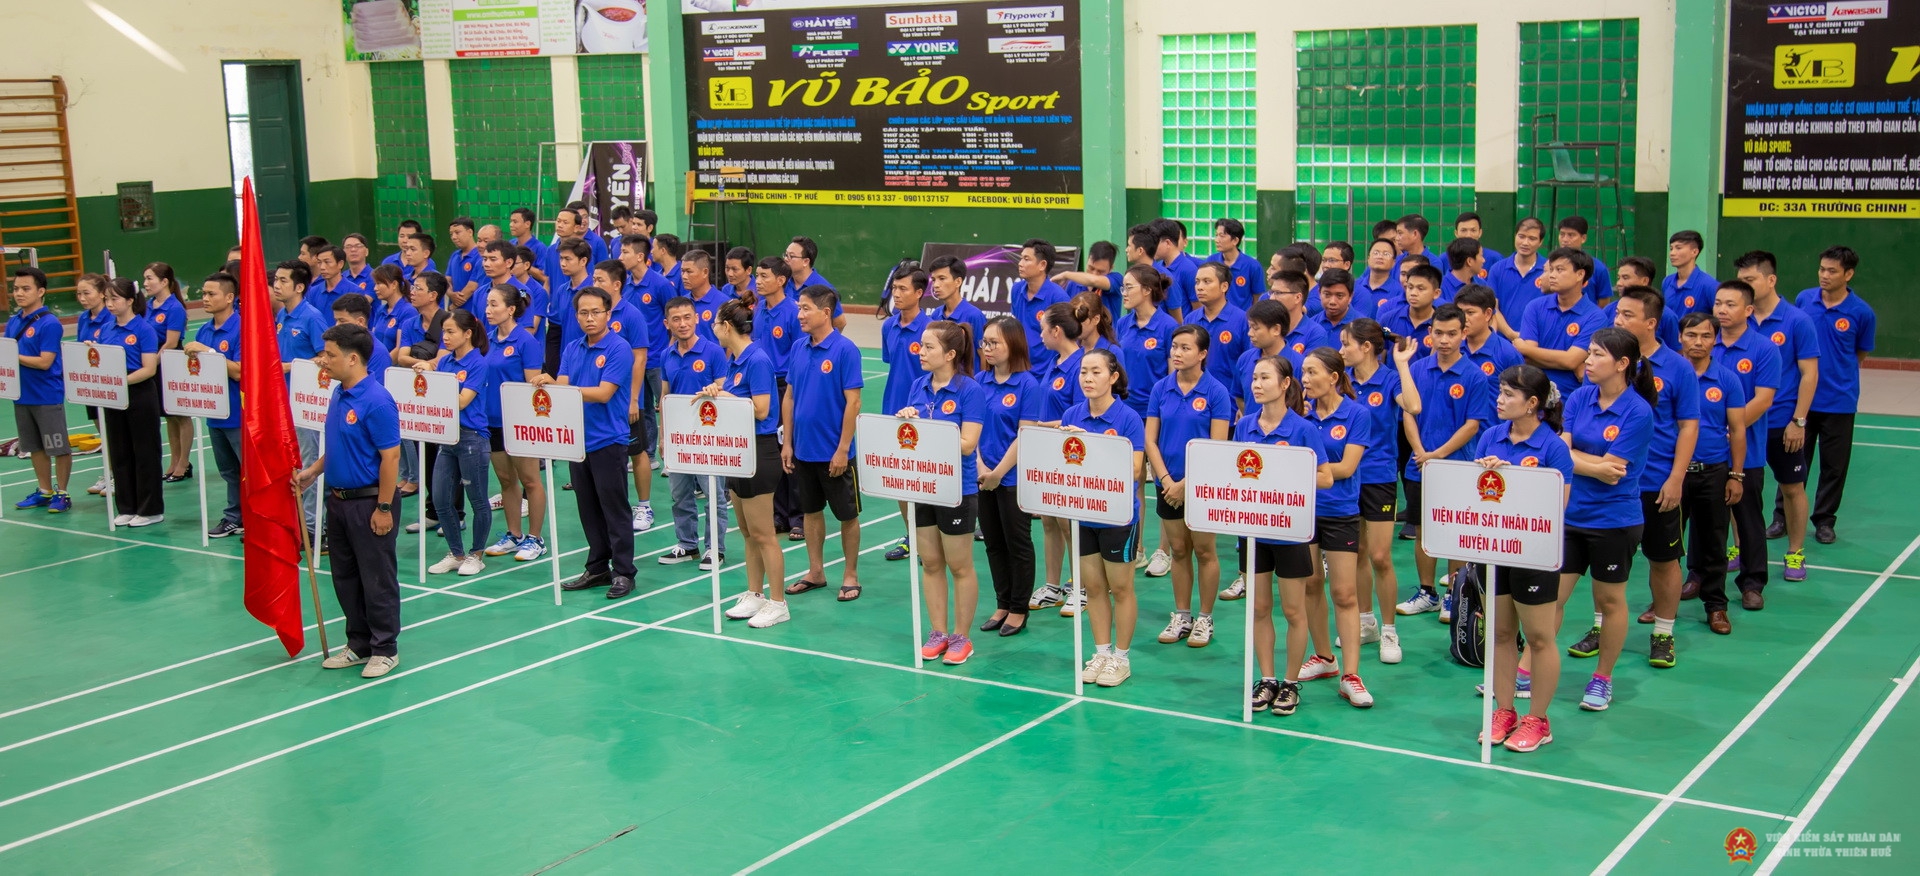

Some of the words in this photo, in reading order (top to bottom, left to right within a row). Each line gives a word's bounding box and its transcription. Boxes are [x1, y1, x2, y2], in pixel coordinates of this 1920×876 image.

[1004, 12, 1048, 20] Flypower
[1784, 5, 1826, 16] VICTOR
[1832, 6, 1882, 16] kawasaki
[804, 17, 827, 28] HẢI
[889, 14, 952, 25] Sunbatta
[913, 42, 956, 53] YONEX
[768, 71, 841, 108] VŨ
[850, 68, 970, 106] BẢO
[966, 90, 1061, 115] Sport
[1745, 120, 1764, 137] NHẬN
[1765, 122, 1778, 137] DẠY
[1779, 120, 1794, 134] KÈM
[1795, 119, 1809, 134] CÁC
[1810, 121, 1833, 133] KHUNG
[1834, 118, 1847, 133] GIỜ
[1848, 121, 1865, 133] THEO
[1866, 118, 1882, 133] THỜI
[1883, 120, 1901, 133] GIAN
[1902, 116, 1916, 132] CỦA
[1744, 139, 1753, 153] VŨ
[1754, 138, 1768, 153] BẢO
[1769, 140, 1792, 153] SPORT:
[1744, 157, 1762, 174] NHẬN
[1765, 155, 1774, 171] TỔ
[1774, 157, 1792, 171] CHỨC
[1794, 156, 1807, 171] GIẢI
[1809, 159, 1823, 171] CHO
[1824, 157, 1838, 171] CÁC
[1839, 158, 1849, 171] CƠ
[1850, 159, 1870, 172] QUAN,
[1872, 157, 1891, 171] ĐOÀN
[1743, 176, 1762, 192] NHẬN
[1792, 176, 1802, 190] CỜ
[1802, 174, 1818, 191] GIẢI,
[1820, 177, 1833, 190] LƯU
[1834, 176, 1854, 193] NIỆM,
[1855, 178, 1868, 190] HUY
[1870, 177, 1899, 190] CHƯƠNG
[1900, 176, 1914, 190] CÁC
[766, 192, 787, 200] CHINH
[794, 192, 802, 200] TP
[804, 190, 818, 200] HUẾ
[847, 193, 865, 201] 0905
[867, 194, 879, 202] 613
[882, 194, 896, 202] 337
[904, 195, 949, 203] 0901137157
[968, 196, 1010, 204] FACEBOOK:
[1025, 194, 1042, 204] BẢO
[1044, 196, 1070, 205] SPORT
[1759, 202, 1779, 212] ĐC:
[1784, 203, 1807, 212] 33A
[1810, 200, 1862, 212] TRƯỜNG
[1866, 203, 1907, 212] CHINH
[960, 267, 1000, 303] HẢI
[168, 380, 179, 393] VIỆN
[179, 380, 190, 392] KIỂM
[191, 382, 199, 393] SÁT
[200, 383, 213, 394] NHÂN
[214, 384, 223, 395] DÂN
[177, 396, 191, 410] HUYỆN
[192, 399, 202, 409] NAM
[295, 391, 305, 404] VIỆN
[306, 391, 318, 405] KIỂM
[319, 395, 328, 407] SÁT
[403, 400, 415, 414] KIỂM
[416, 403, 425, 415] SÁT
[426, 404, 441, 417] NHÂN
[442, 406, 453, 418] DÂN
[414, 421, 431, 433] HƯƠNG
[432, 421, 445, 434] THỦY
[514, 424, 553, 445] TRỌNG
[556, 425, 574, 445] TÀI
[670, 431, 685, 448] VIỆN
[686, 430, 702, 446] KIỂM
[703, 432, 715, 447] SÁT
[716, 433, 734, 448] NHÂN
[735, 434, 748, 449] DÂN
[678, 450, 691, 464] TỈNH
[692, 450, 709, 465] THỪA
[710, 452, 728, 466] THIÊN
[729, 452, 742, 467] HUẾ
[865, 452, 881, 469] VIỆN
[882, 452, 901, 470] KIỂM
[902, 455, 916, 471] SÁT
[917, 458, 937, 474] NHÂN
[939, 459, 954, 476] DÂN
[882, 474, 905, 490] THÀNH
[907, 475, 921, 492] PHỐ
[922, 477, 937, 494] HUẾ
[1026, 467, 1044, 484] VIỆN
[1045, 467, 1065, 485] KIỂM
[1066, 471, 1081, 487] SÁT
[1082, 474, 1106, 491] NHÂN
[1107, 476, 1124, 494] DÂN
[1042, 490, 1067, 509] HUYỆN
[1068, 493, 1085, 510] PHÚ
[1086, 496, 1108, 513] VANG
[1195, 483, 1215, 501] VIỆN
[1216, 483, 1238, 501] KIỂM
[1240, 486, 1258, 503] SÁT
[1259, 488, 1284, 506] NHÂN
[1286, 490, 1305, 508] DÂN
[1208, 505, 1235, 524] HUYỆN
[1236, 510, 1268, 526] PHONG
[1270, 510, 1291, 529] ĐIỀN
[1432, 506, 1453, 525] VIỆN
[1456, 506, 1479, 526] KIỂM
[1482, 511, 1499, 528] SÁT
[1502, 513, 1528, 531] NHÂN
[1531, 516, 1551, 533] DÂN
[1459, 534, 1489, 553] HUYỆN
[1492, 539, 1498, 552] A
[1501, 537, 1522, 554] LƯỚI
